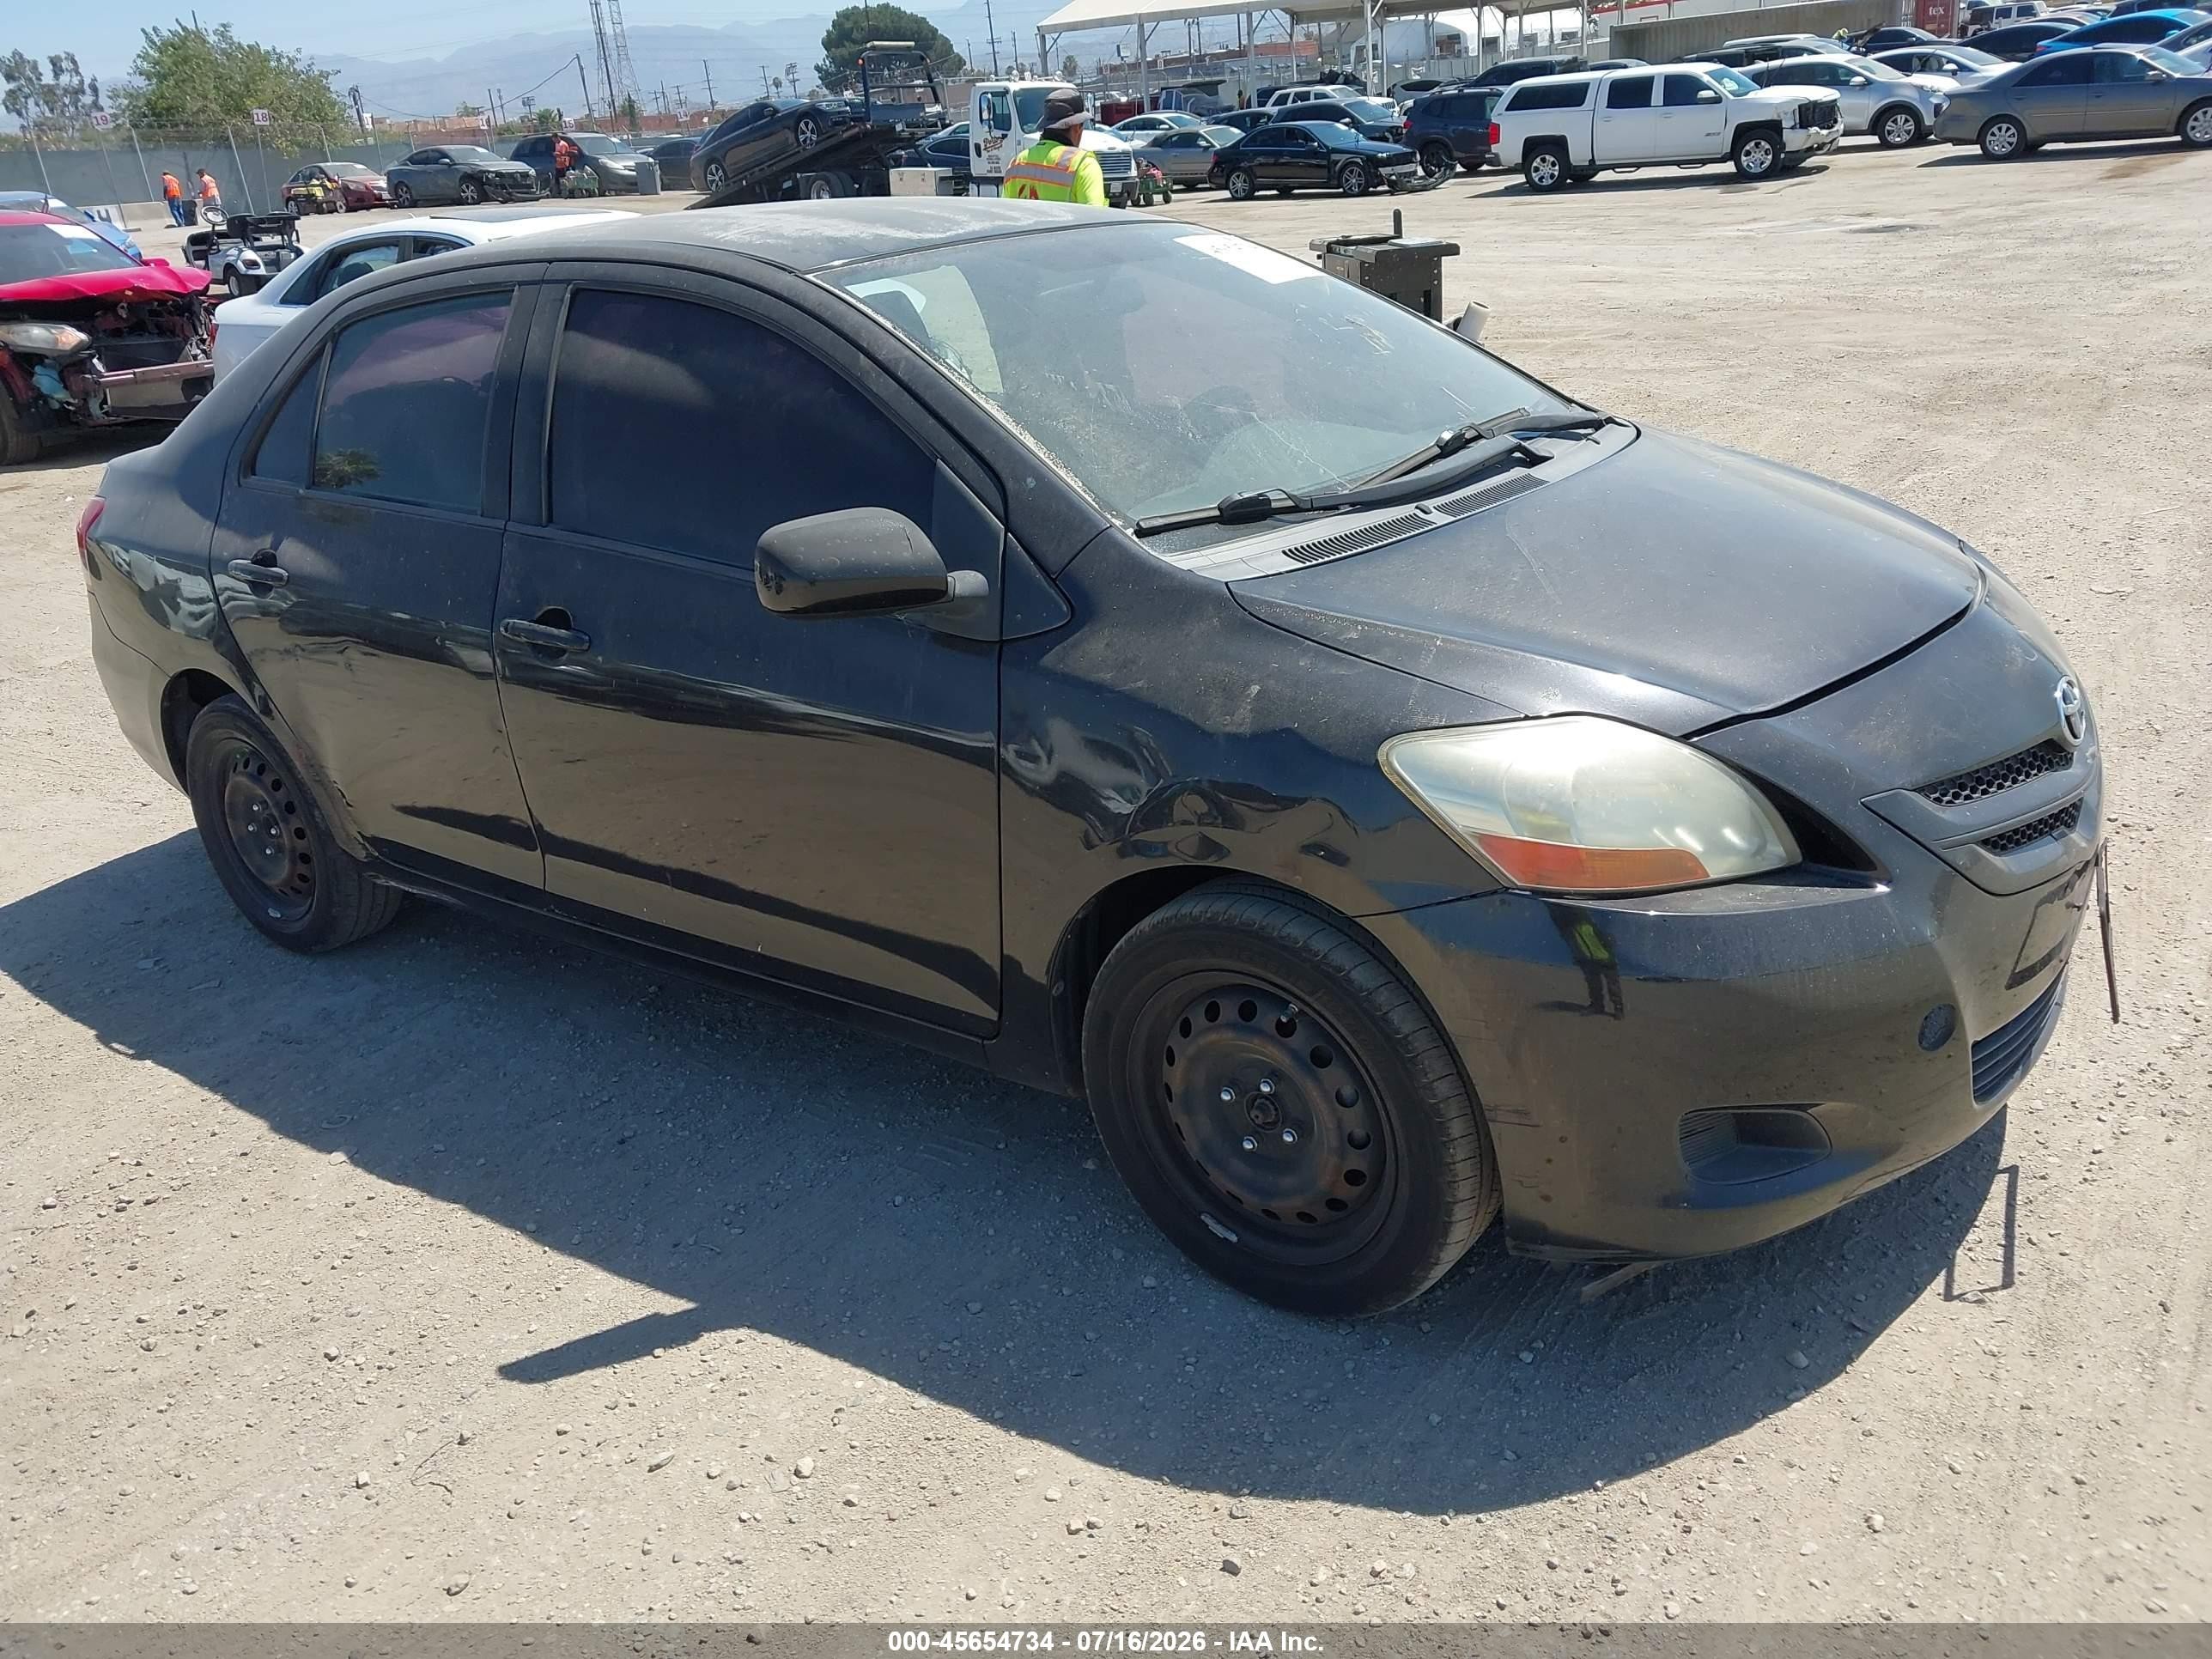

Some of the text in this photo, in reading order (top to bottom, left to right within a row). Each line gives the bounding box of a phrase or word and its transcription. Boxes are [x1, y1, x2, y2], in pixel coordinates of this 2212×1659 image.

[1929, 7, 1945, 15] tex
[95, 115, 108, 126] 19
[254, 112, 268, 122] 18
[562, 120, 574, 129] 15
